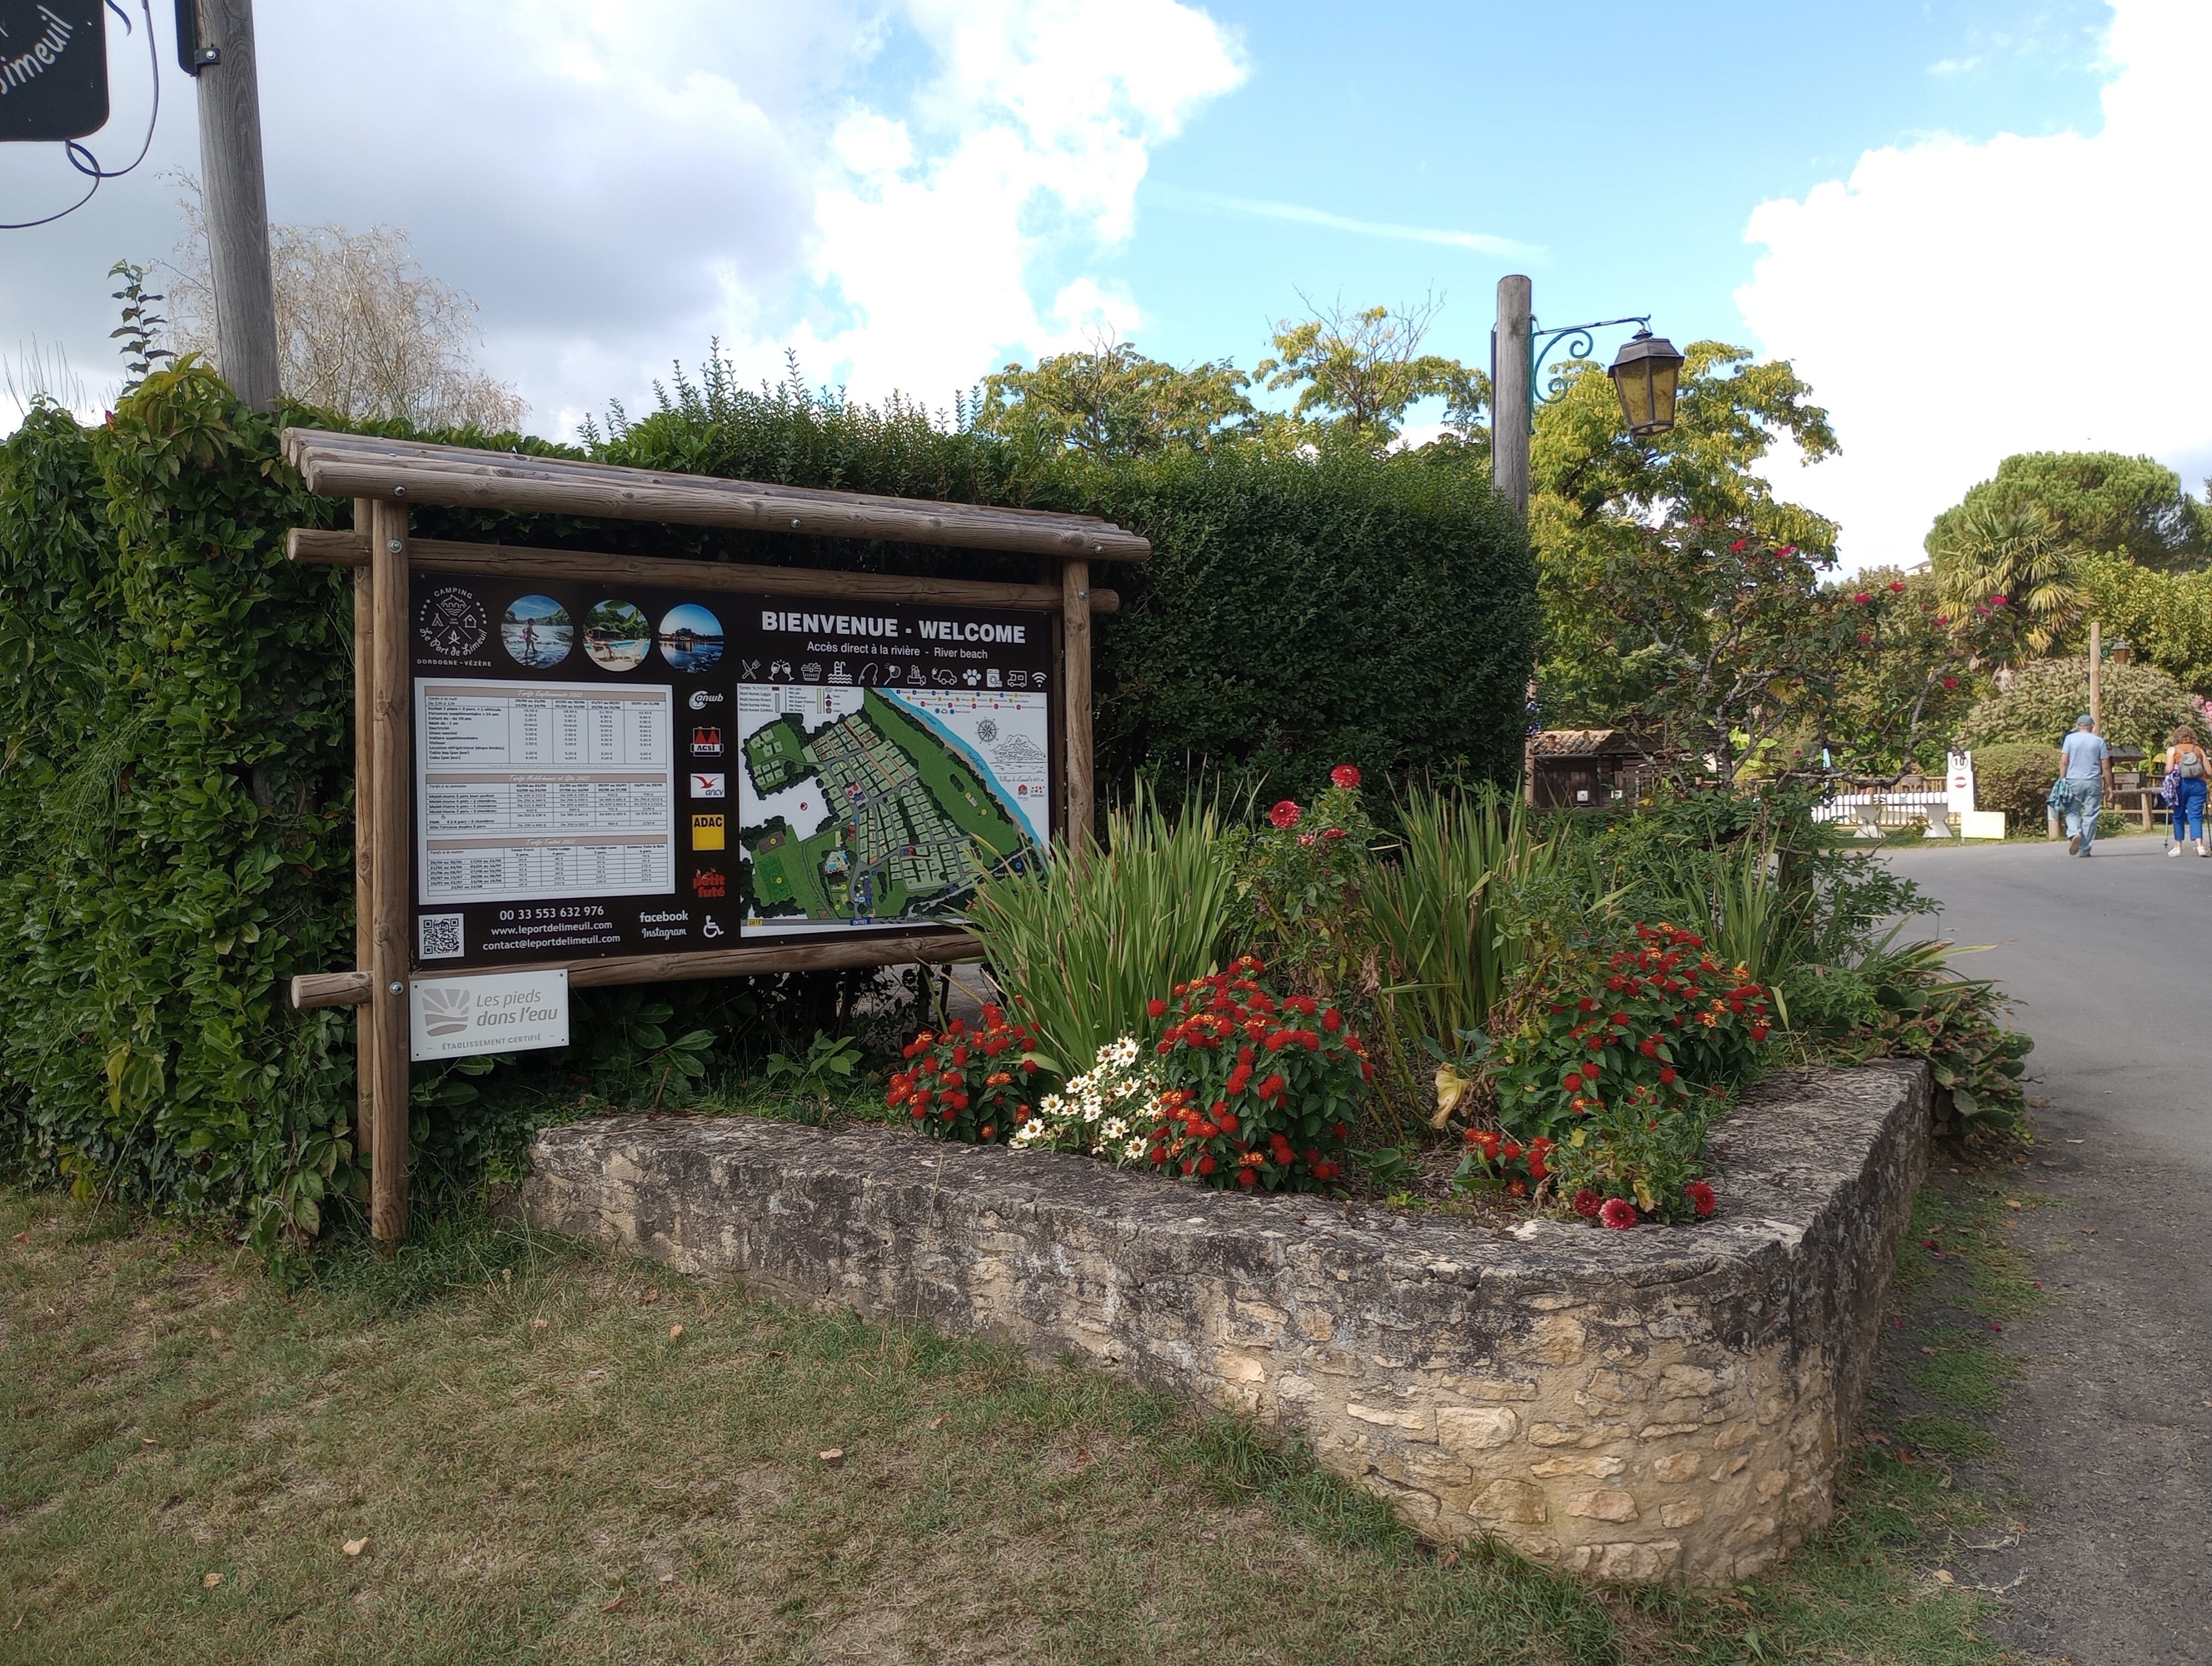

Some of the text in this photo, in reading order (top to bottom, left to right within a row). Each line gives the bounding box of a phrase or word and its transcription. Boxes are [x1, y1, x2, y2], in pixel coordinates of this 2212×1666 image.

[434, 586, 473, 599] CAMPING
[761, 611, 899, 637] BIENVENUE
[919, 620, 1026, 643] WELCOME
[430, 637, 449, 656] Port
[451, 646, 461, 656] de
[461, 628, 488, 656] Limeuil
[806, 641, 838, 652] Accès
[840, 642, 869, 654] direct
[871, 644, 878, 655] à
[879, 644, 889, 655] la
[891, 645, 920, 656] rivière
[934, 646, 958, 658] River
[959, 648, 988, 659] beach
[694, 816, 723, 828] ADAC
[693, 873, 725, 889] petit
[698, 885, 725, 898] futé
[500, 905, 605, 920] 00 33 553 632 976
[639, 910, 689, 923] facebook
[491, 921, 613, 935] www.leportdelimeuil.com
[641, 927, 687, 940] Instagram
[482, 935, 620, 950] contact@leportdelimeuil.com
[476, 989, 541, 1009] Les pieds
[476, 1006, 558, 1026] dans l'eau
[441, 1033, 541, 1050] ÉTABLISSEMENT CERTIFIÉ
